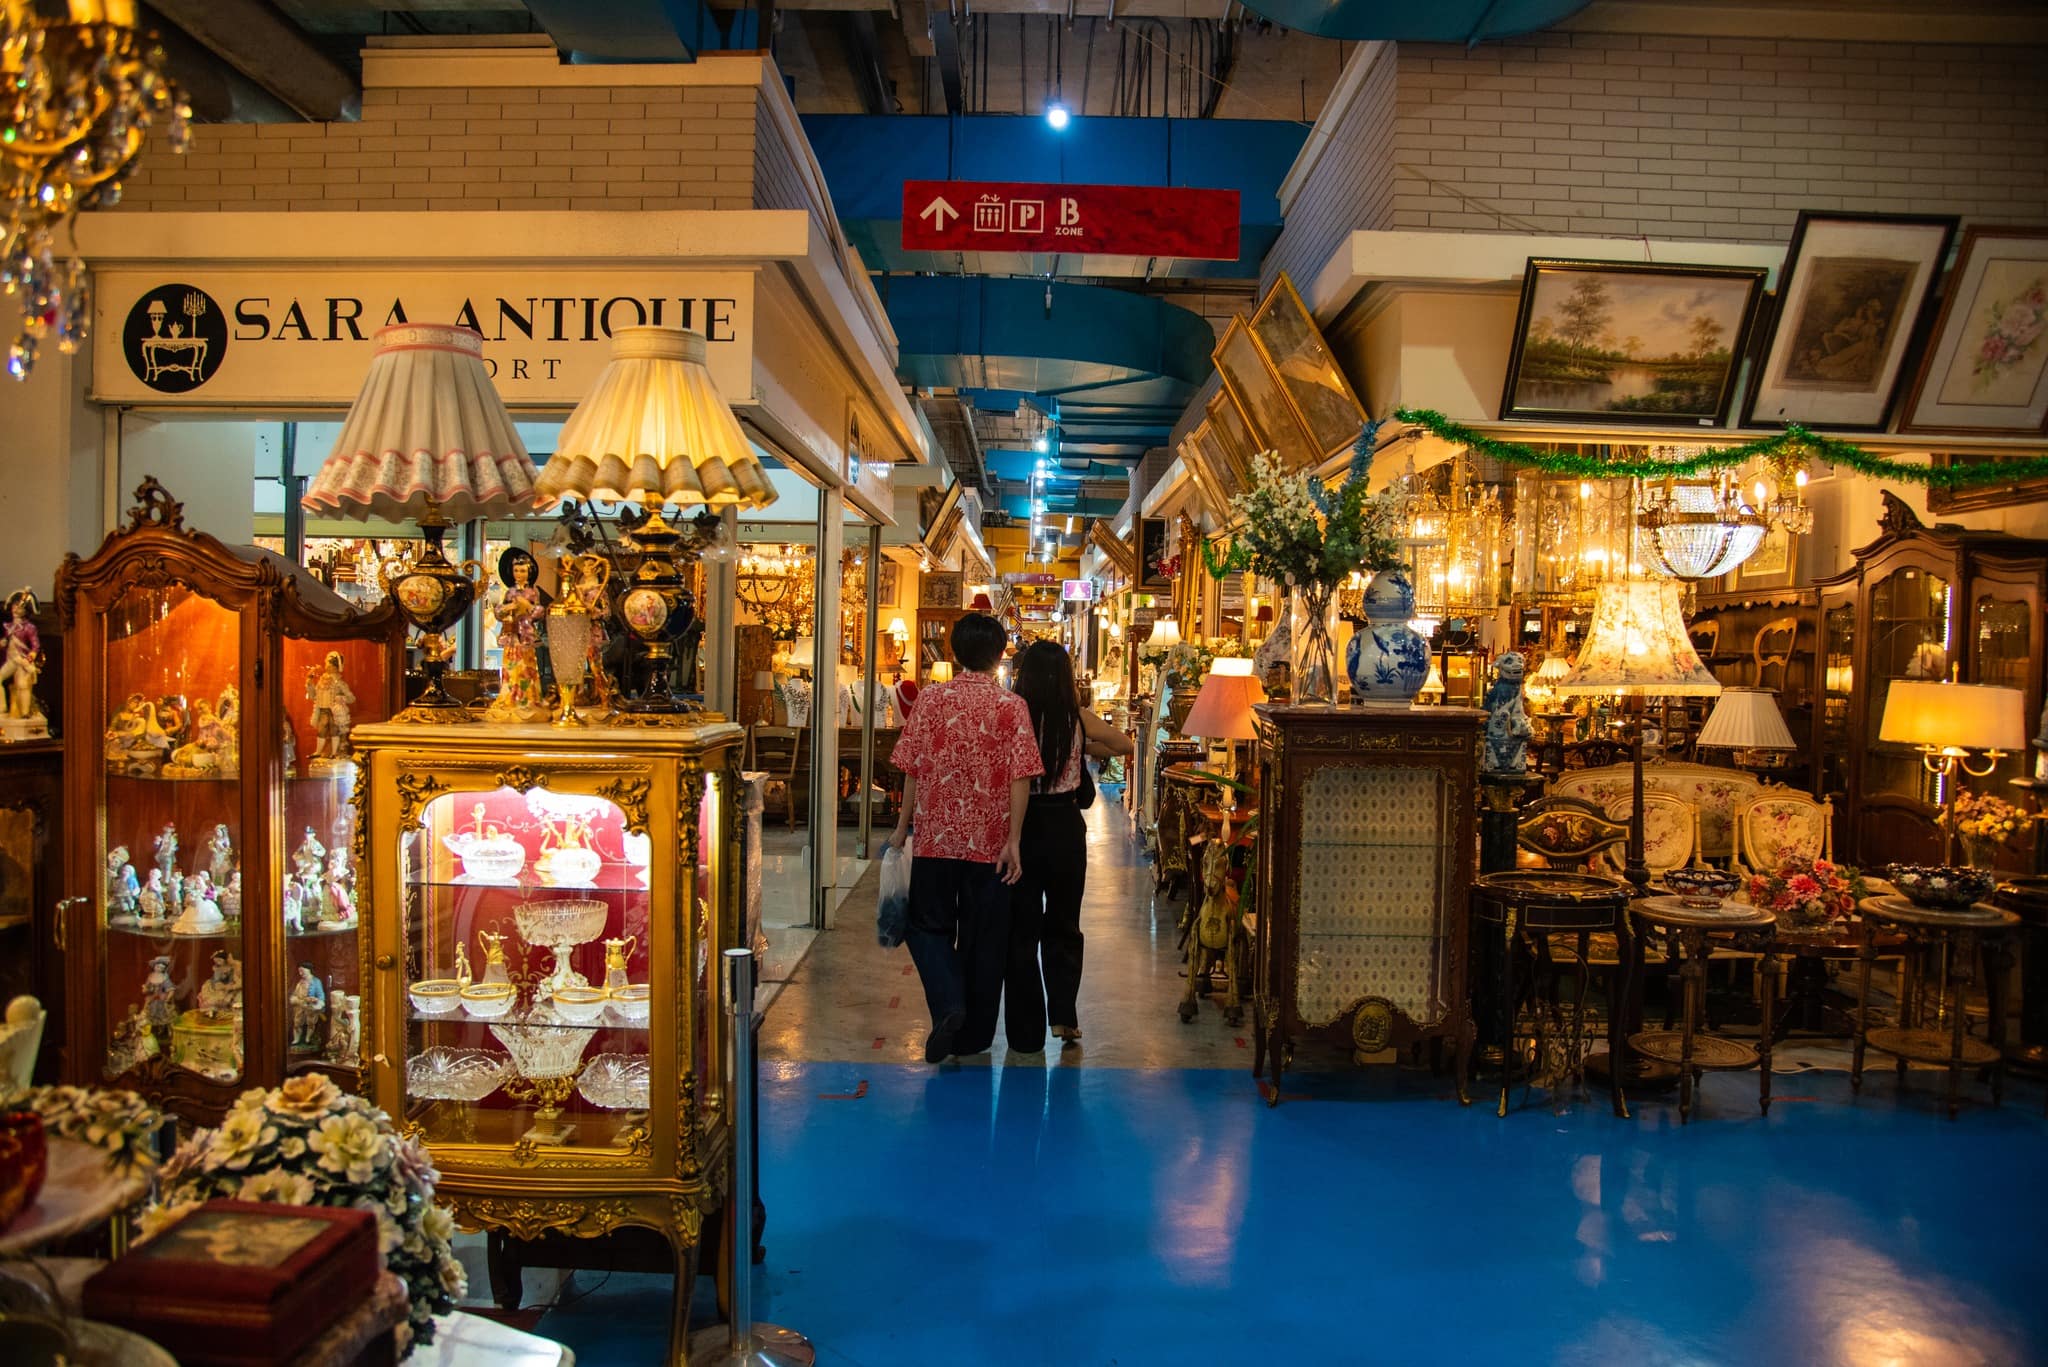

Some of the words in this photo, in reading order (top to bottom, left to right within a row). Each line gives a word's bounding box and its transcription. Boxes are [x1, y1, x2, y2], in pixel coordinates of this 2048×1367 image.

[1020, 204, 1036, 227] P
[1061, 198, 1080, 226] B
[1055, 227, 1084, 237] ZONE
[482, 358, 561, 380] ORT
